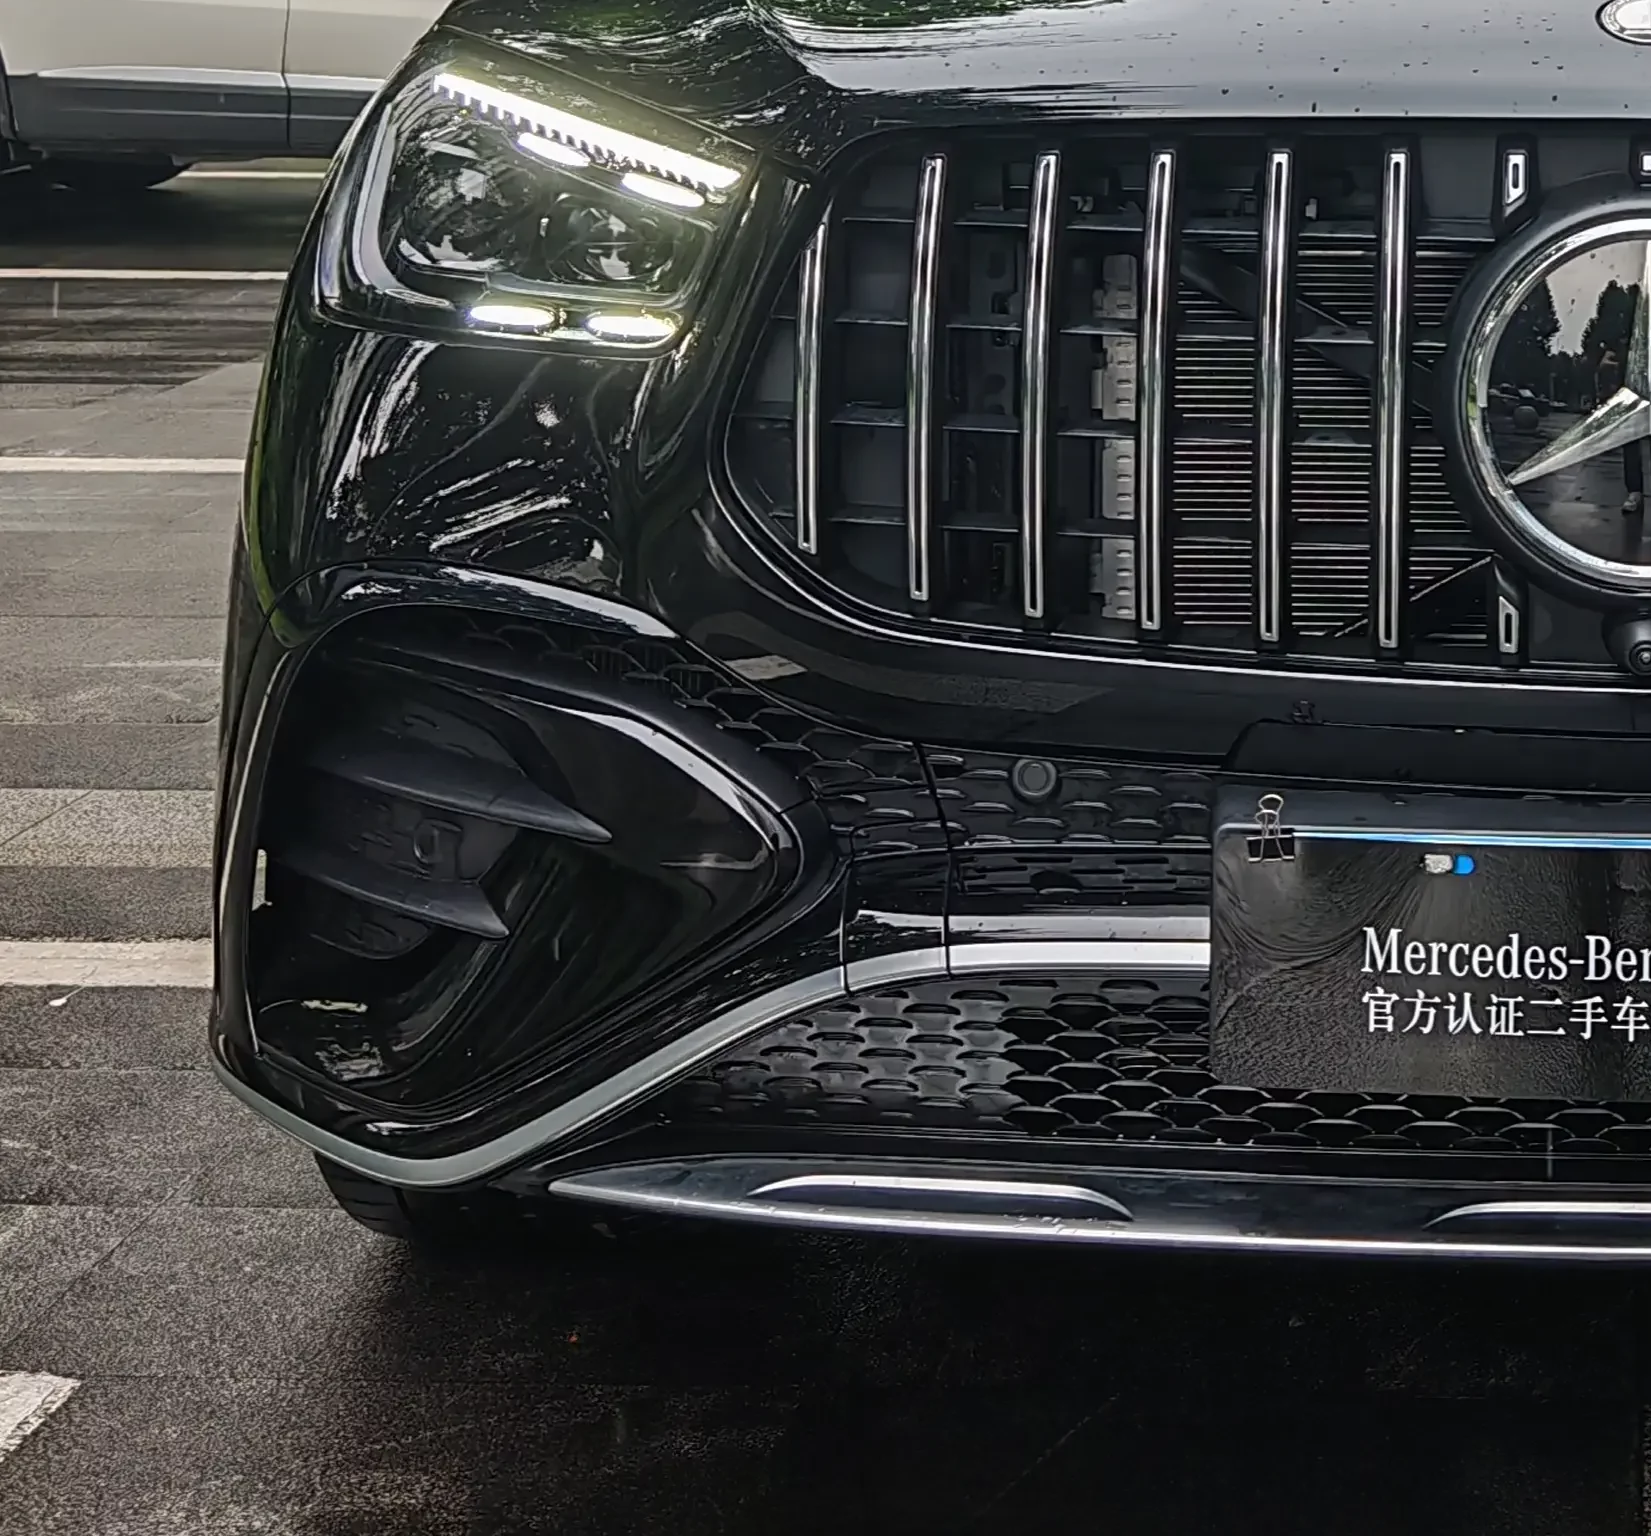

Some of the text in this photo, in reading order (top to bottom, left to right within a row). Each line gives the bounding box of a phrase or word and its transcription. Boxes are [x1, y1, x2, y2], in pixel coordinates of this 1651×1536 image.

[1361, 986, 1651, 1042] 官方认证二手车
